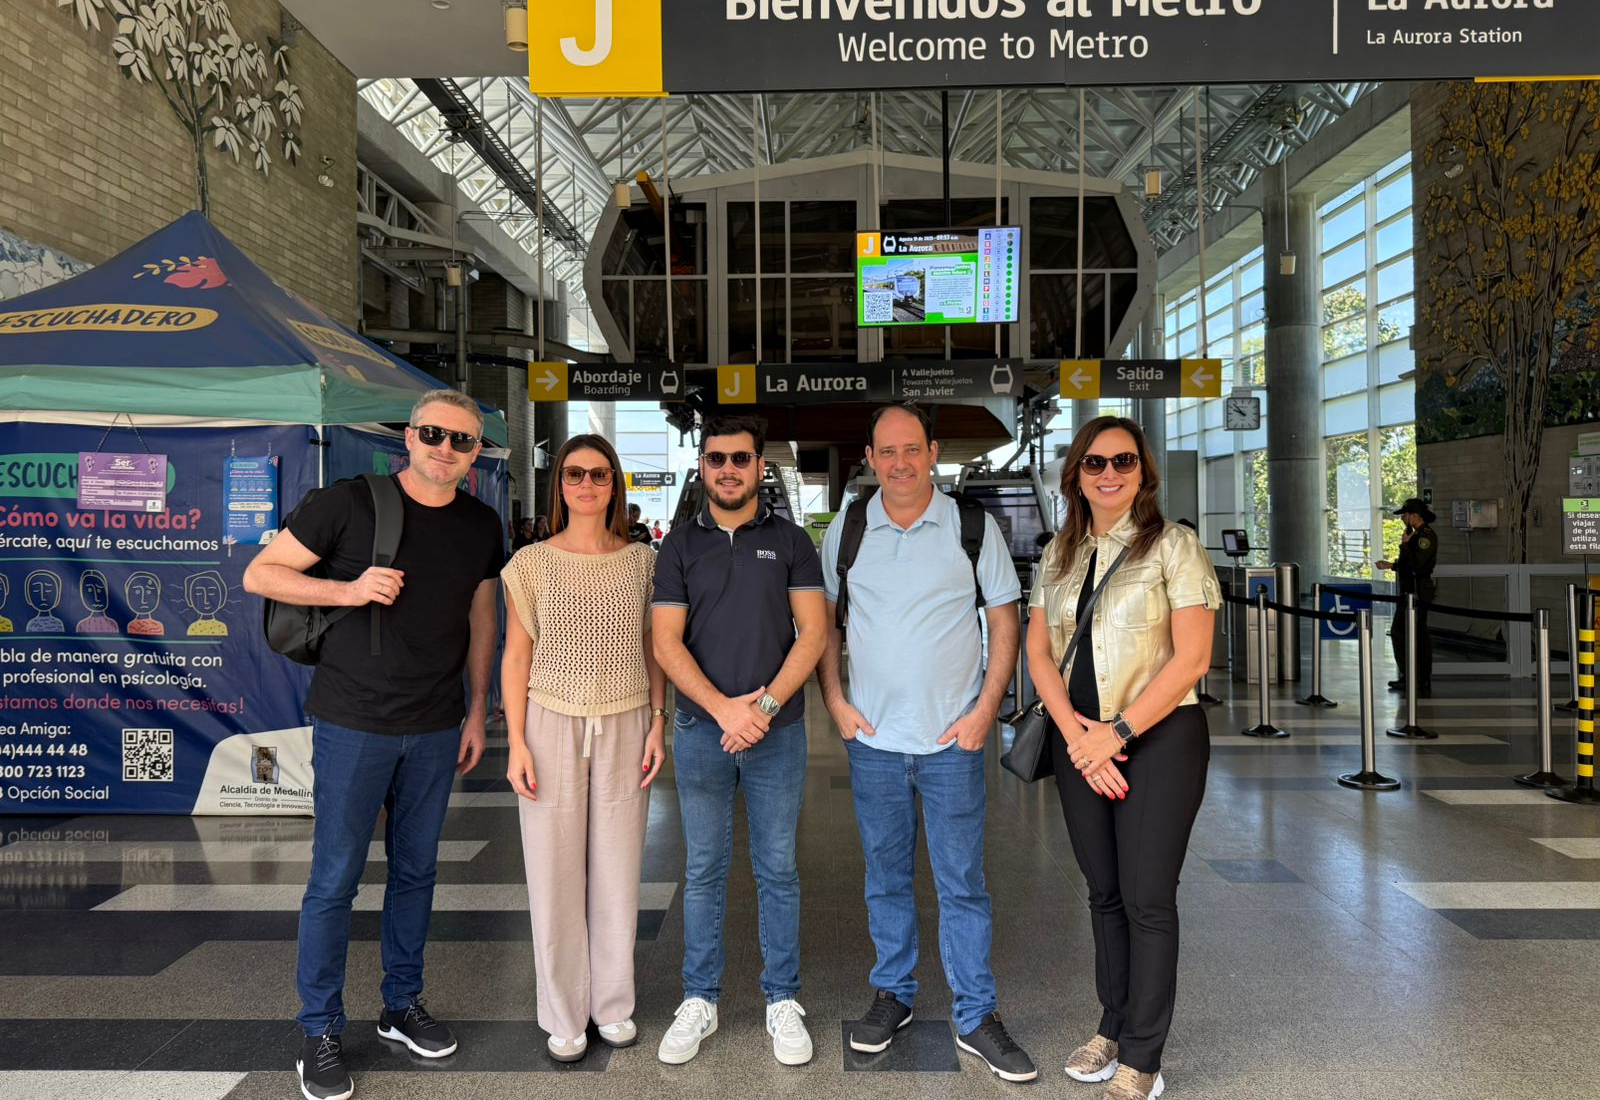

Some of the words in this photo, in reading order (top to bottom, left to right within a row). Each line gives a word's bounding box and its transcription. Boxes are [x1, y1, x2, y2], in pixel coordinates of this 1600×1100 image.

[559, 0, 613, 67] J
[1366, 30, 1386, 45] La
[1392, 29, 1453, 44] Aurora
[1459, 27, 1523, 44] Station
[838, 31, 987, 62] Welcome
[1000, 32, 1035, 60] to
[1050, 28, 1149, 59] Metro
[863, 236, 874, 254] J
[908, 244, 934, 252] Aurora
[0, 309, 197, 328] ESCUCHADERO
[572, 369, 642, 386] Abordaje
[902, 378, 928, 386] Towards
[934, 377, 974, 386] Vallejuelos
[911, 368, 955, 378] Vallejuelos
[1116, 366, 1164, 381] Salida
[584, 385, 631, 396] Boarding
[724, 371, 740, 397] J
[765, 375, 788, 393] La
[796, 374, 868, 392] Aurora
[902, 387, 921, 397] San
[924, 386, 955, 397] Javier
[1129, 381, 1150, 392] Exit
[66, 513, 96, 529] va
[103, 508, 127, 530] la
[133, 507, 202, 530] vida?
[1572, 519, 1596, 528] viajar
[56, 533, 93, 552] aquí
[96, 535, 112, 550] te
[116, 535, 219, 551] escuchamos
[0, 648, 26, 663] bla
[31, 648, 51, 663] de
[57, 651, 118, 664] manera
[123, 651, 187, 668] gratuita
[191, 655, 223, 667] con
[3, 669, 94, 687] profesional
[98, 672, 117, 684] en
[121, 670, 207, 689] psicología.
[63, 693, 121, 709] donde
[125, 697, 153, 710] nos
[156, 697, 244, 714] necesitas!
[20, 722, 71, 739] Amiga:
[0, 744, 43, 760] 4)444
[46, 744, 65, 756] 44
[69, 744, 88, 756] 48
[27, 765, 53, 778] 723
[56, 765, 86, 778] 1123
[8, 786, 60, 803] Opción
[64, 785, 109, 800] Social
[220, 784, 257, 795] Alcaldía
[260, 785, 272, 795] de
[274, 786, 313, 798] Medellín
[220, 801, 243, 809] Ciencia,
[244, 801, 276, 810] Tecnología
